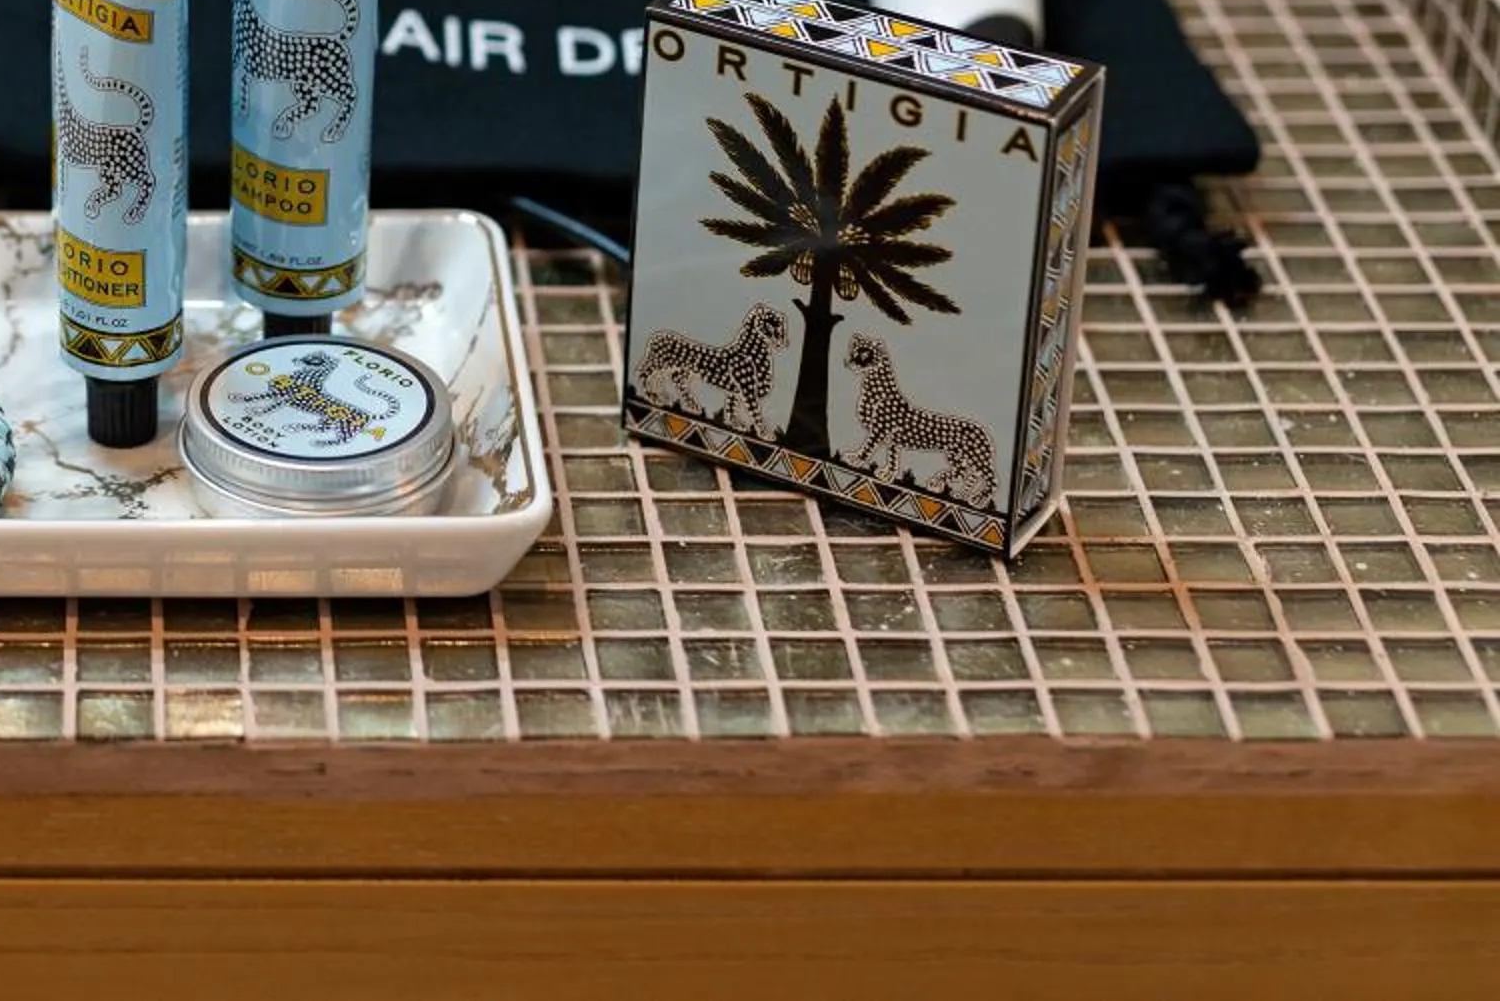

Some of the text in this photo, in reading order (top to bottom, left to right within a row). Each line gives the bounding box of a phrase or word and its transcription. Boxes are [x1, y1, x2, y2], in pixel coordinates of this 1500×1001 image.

[381, 8, 527, 74] AIR
[653, 29, 1038, 163] ORTIGIA
[342, 349, 414, 388] FLORIO
